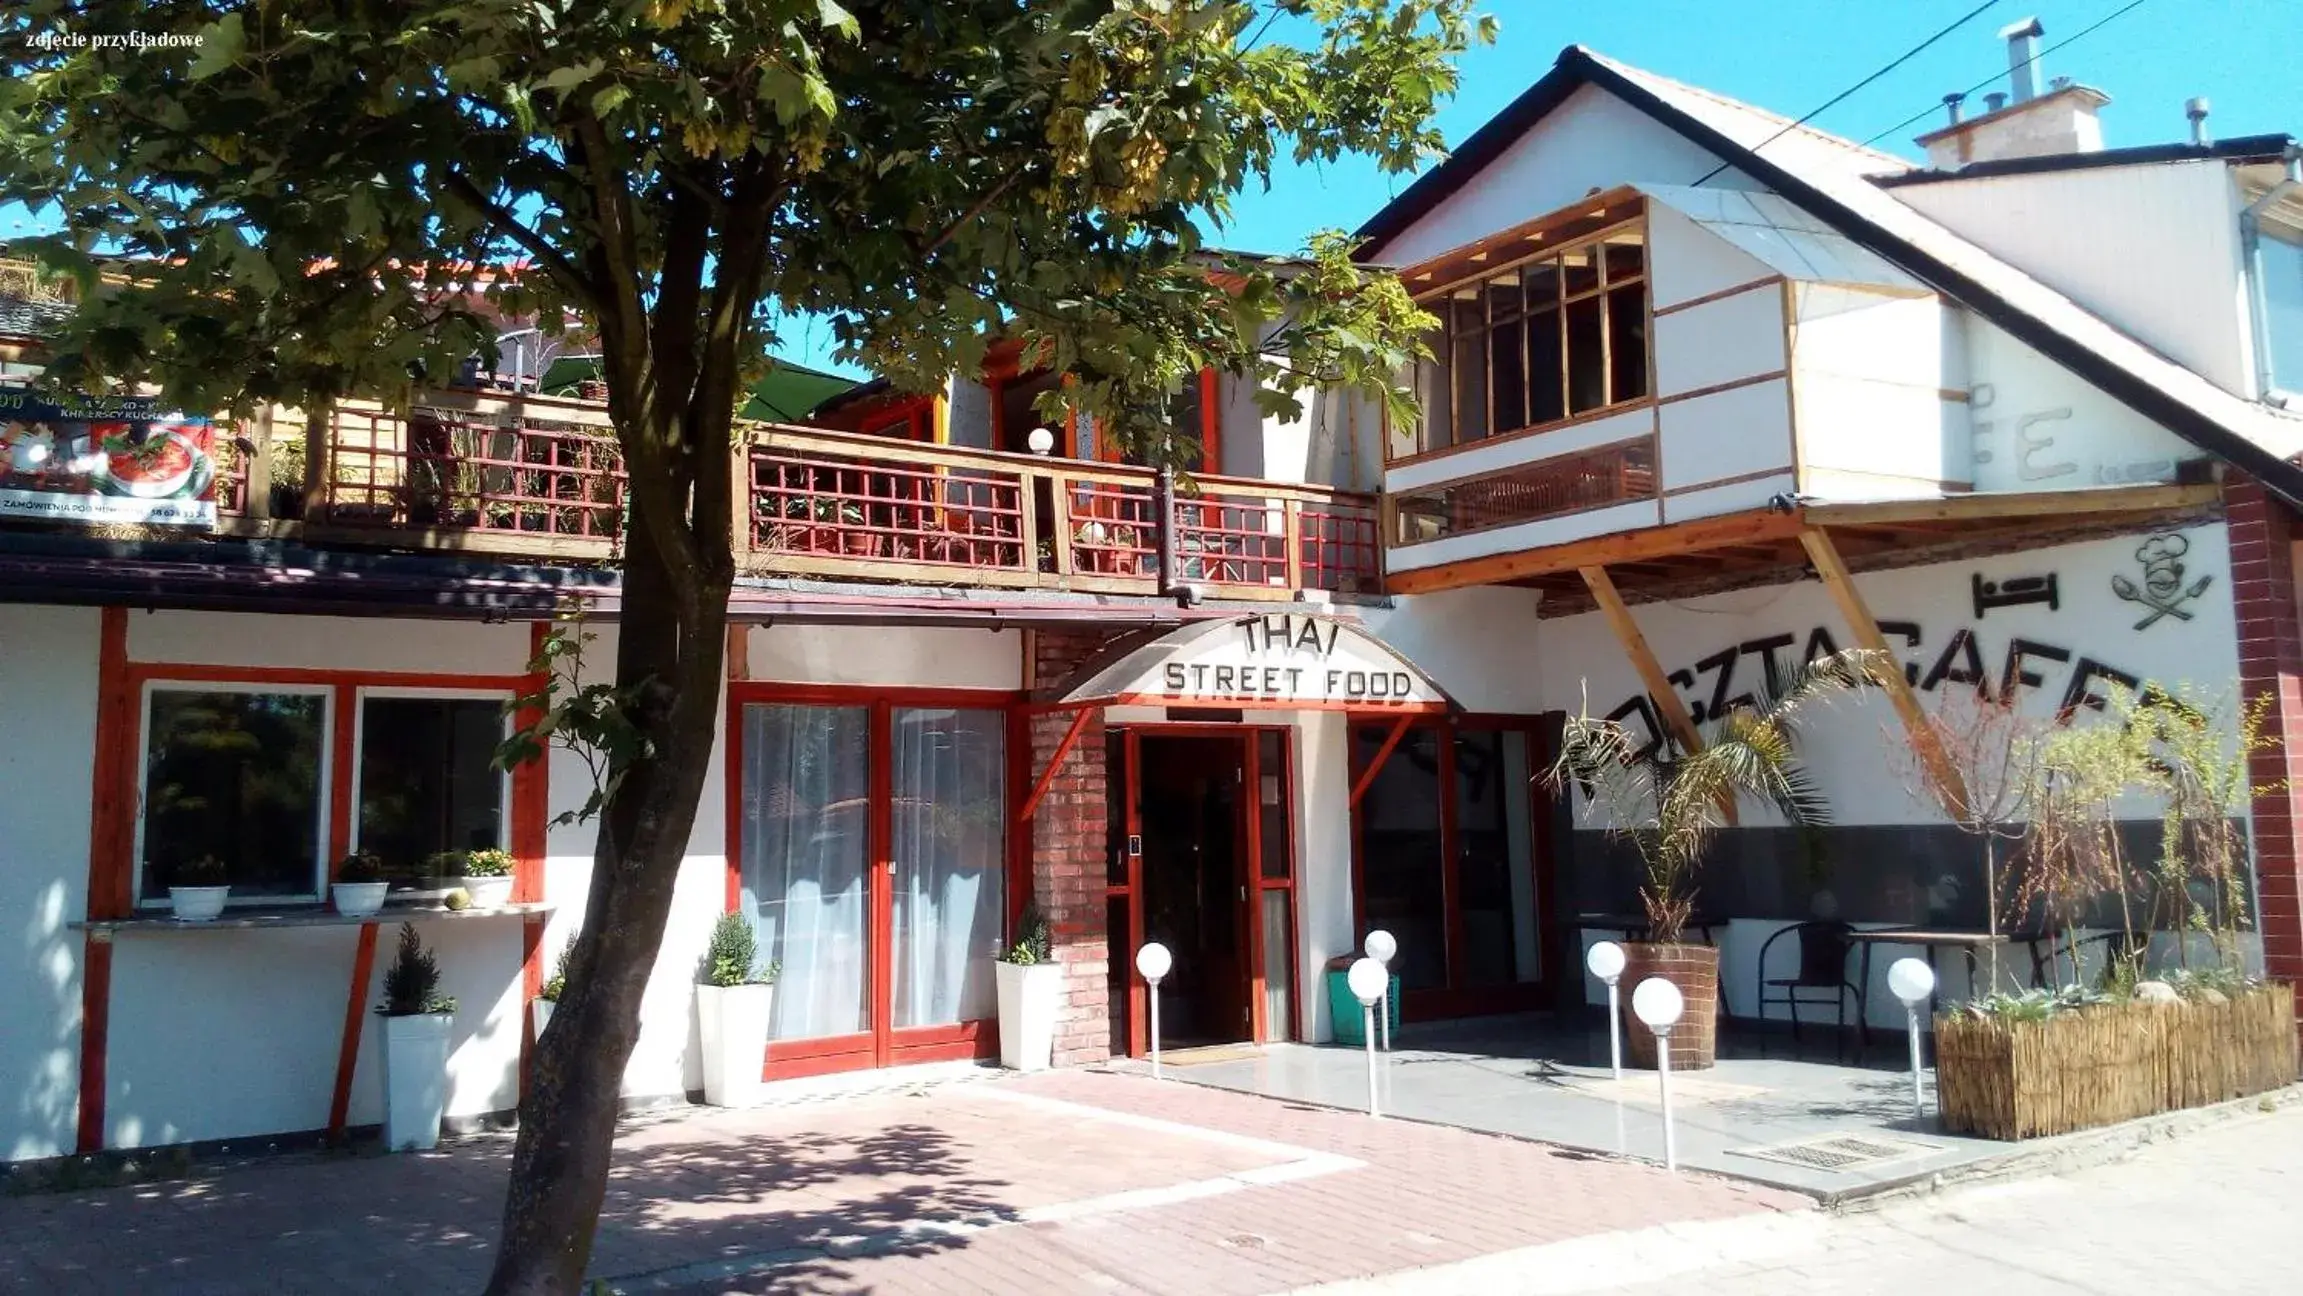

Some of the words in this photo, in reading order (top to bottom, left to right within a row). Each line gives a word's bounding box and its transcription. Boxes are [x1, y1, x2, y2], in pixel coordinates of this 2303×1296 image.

[1236, 614, 1339, 656] THAI
[1166, 663, 1304, 693] STREET
[1327, 670, 1411, 697] FOOD
[1575, 626, 1855, 795] OCZTA
